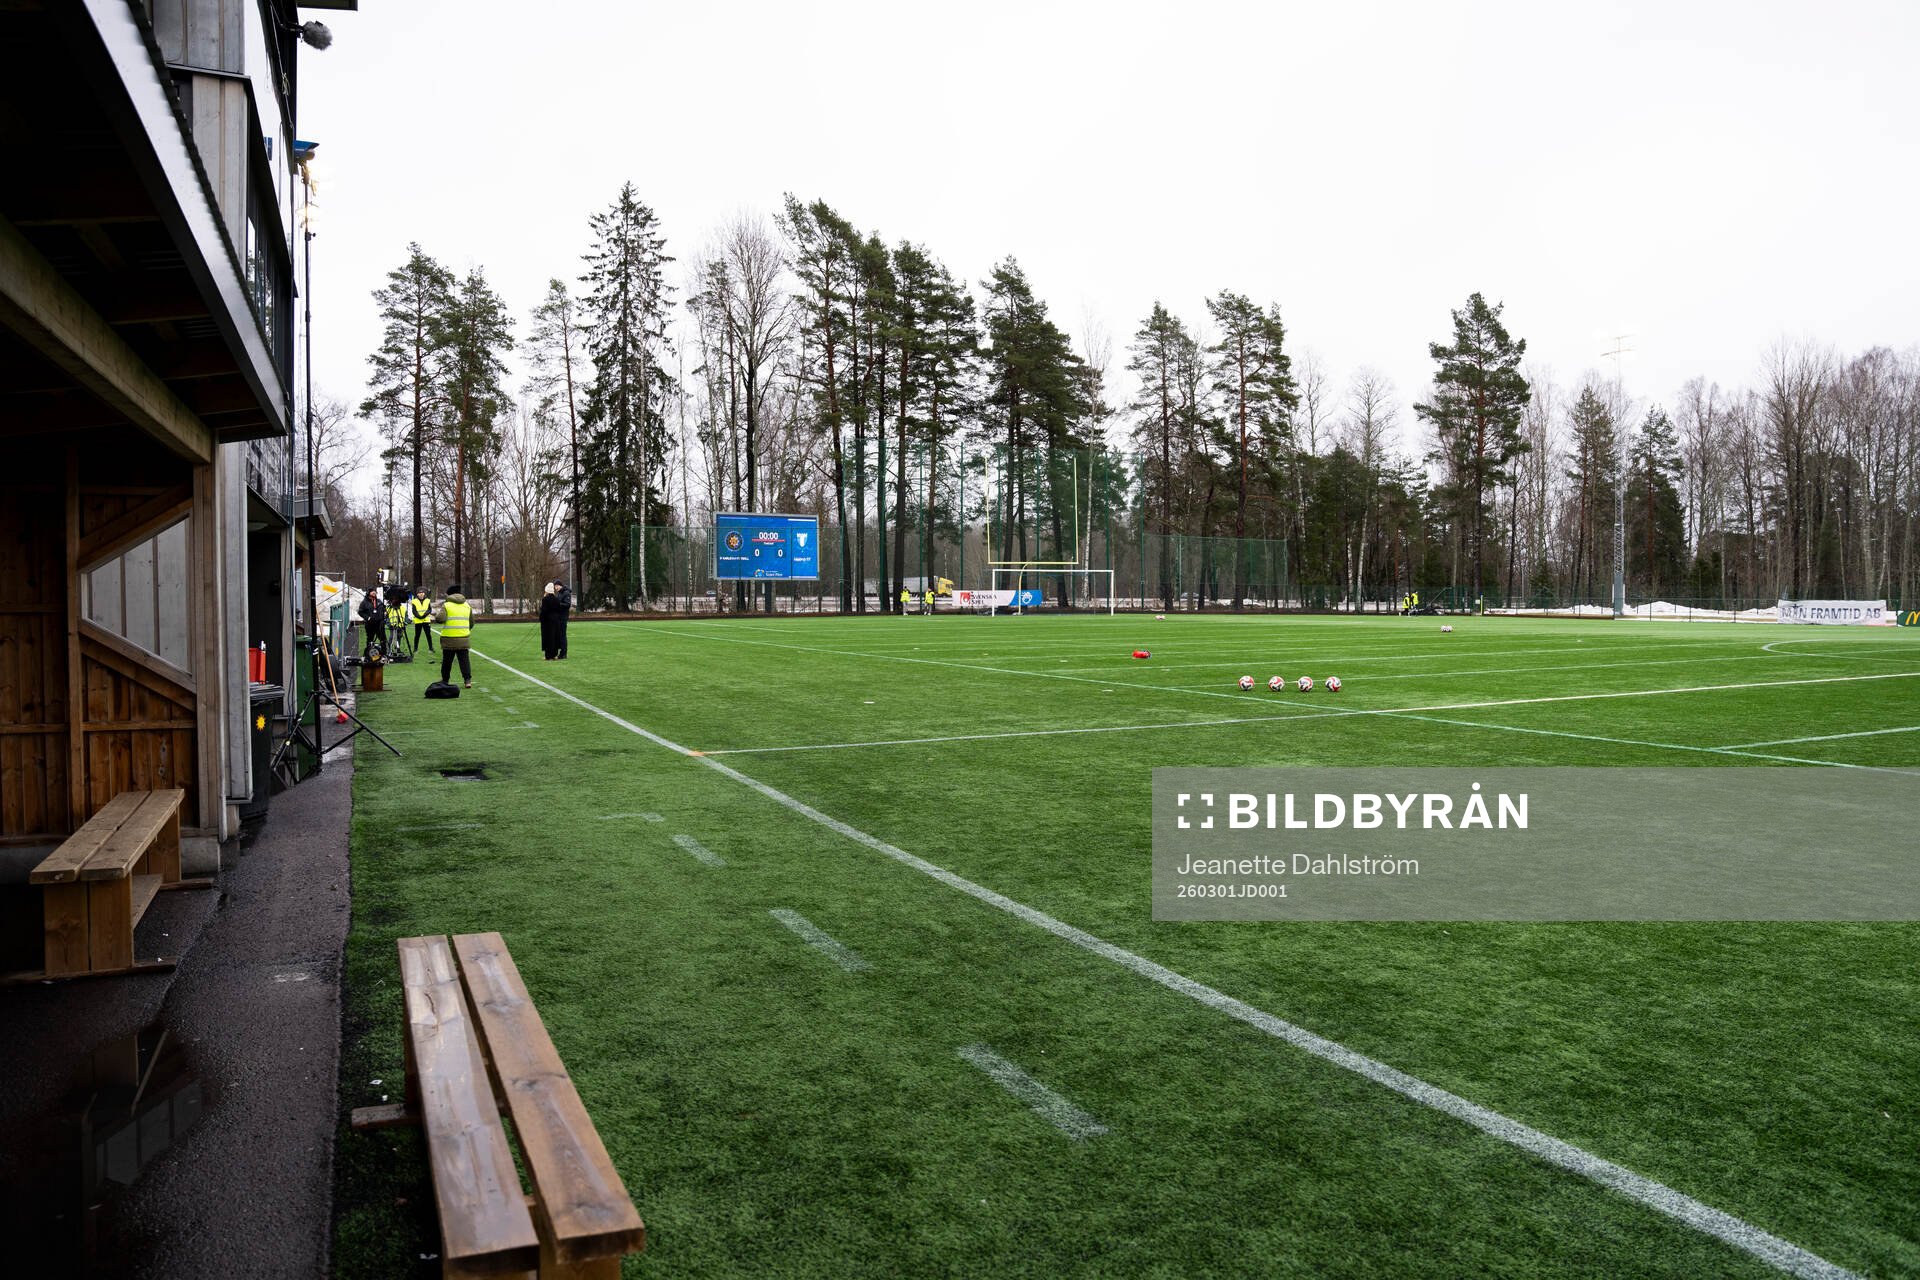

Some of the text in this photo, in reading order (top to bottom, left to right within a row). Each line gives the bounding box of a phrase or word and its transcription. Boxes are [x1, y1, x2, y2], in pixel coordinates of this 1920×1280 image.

[759, 532, 778, 540] 00:00
[755, 548, 783, 557] 0 0
[1811, 607, 1861, 619] FRAMTID
[1865, 607, 1881, 619] AB
